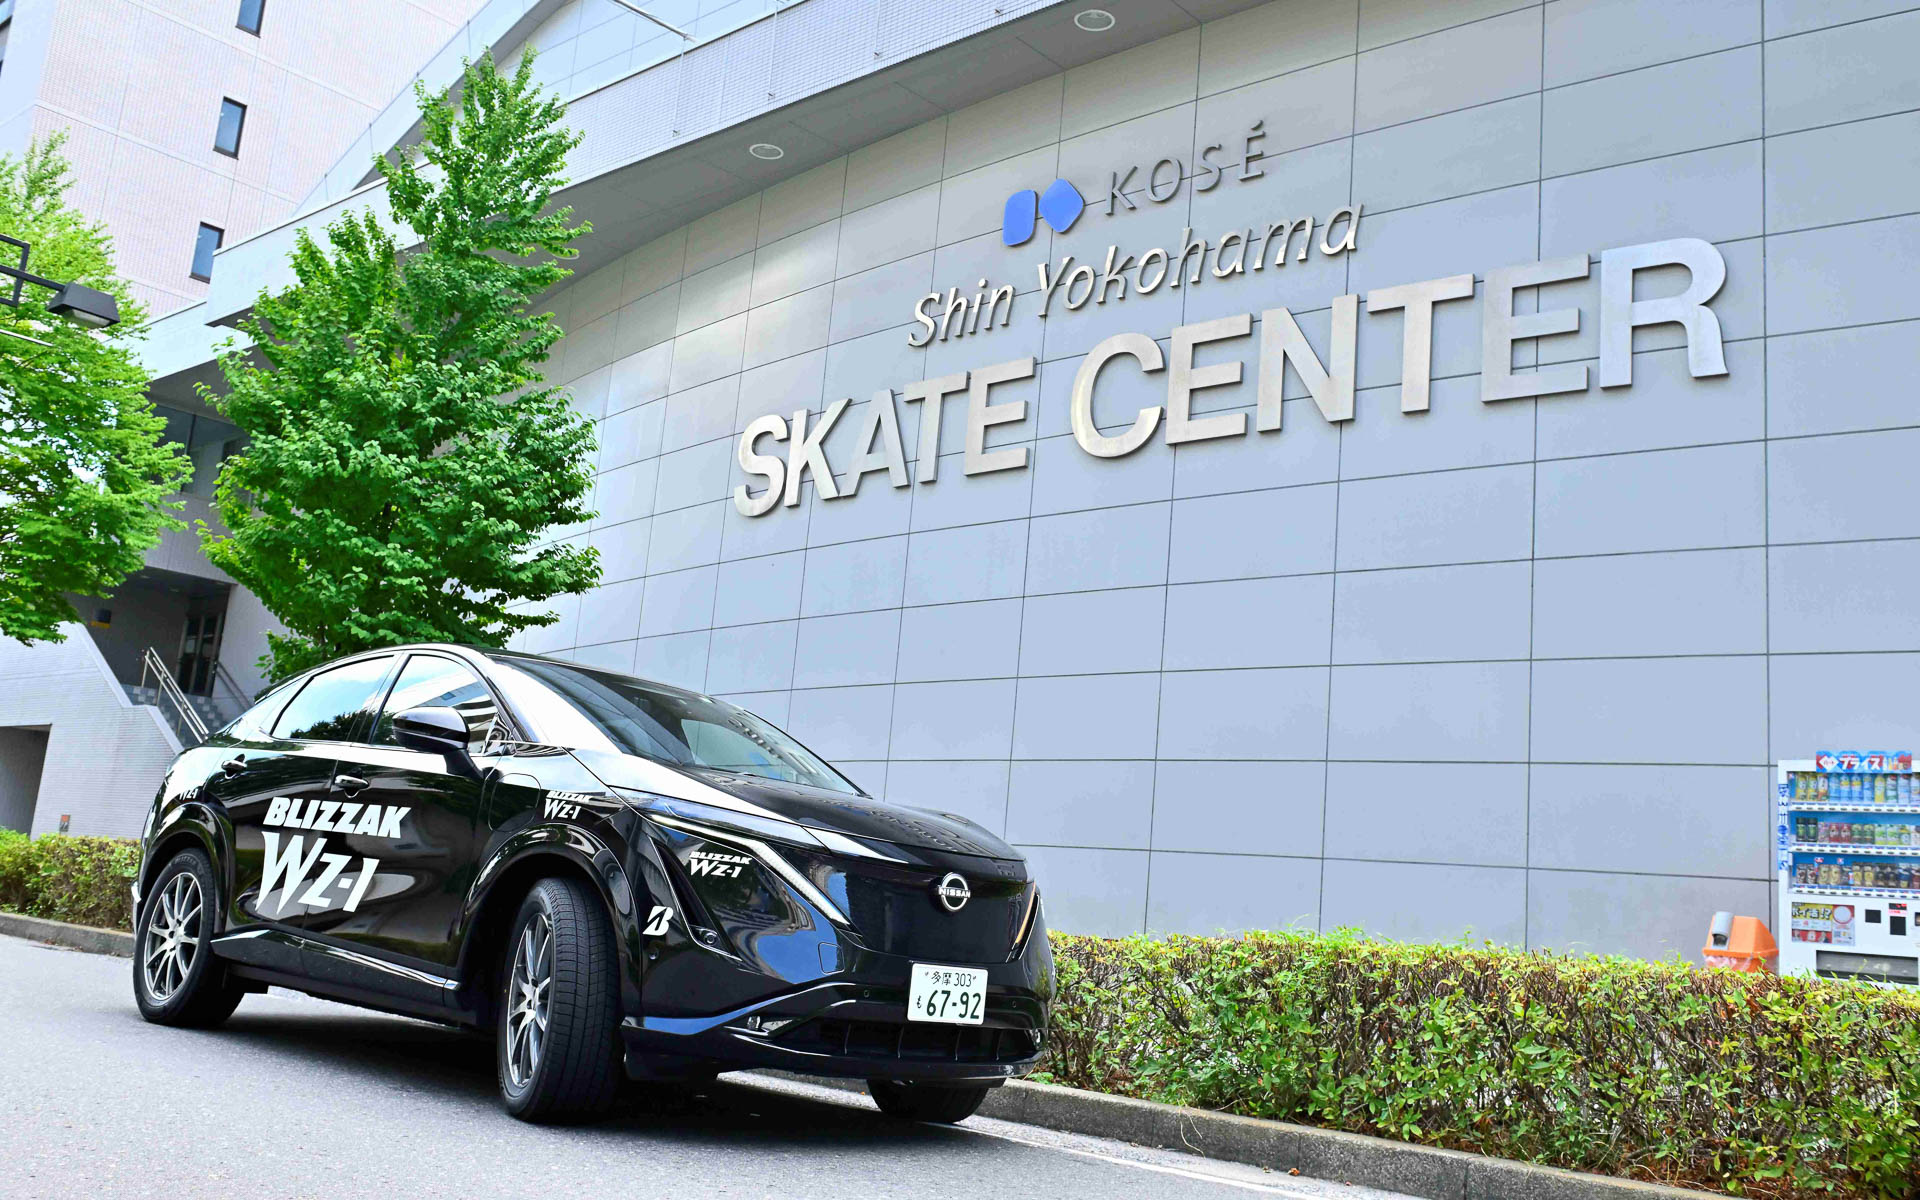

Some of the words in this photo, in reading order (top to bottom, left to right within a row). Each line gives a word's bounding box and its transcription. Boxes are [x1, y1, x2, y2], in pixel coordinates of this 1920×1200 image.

[1105, 121, 1267, 215] KOSÉ
[908, 278, 1016, 347] Shin
[1036, 203, 1363, 318] Yokohama
[734, 356, 1036, 517] SKATE
[1071, 237, 1729, 459] CENTER
[1839, 756, 1881, 771] プライス
[546, 790, 593, 803] BLIZZAK
[263, 796, 412, 839] BLIZZAK
[543, 798, 582, 820] WZ-1
[689, 851, 753, 864] BLIZZAK
[689, 858, 743, 878] WZ-1
[255, 831, 380, 915] WZ-1
[938, 886, 971, 898] NISSAN
[931, 971, 953, 986] 多摩
[954, 972, 972, 987] 303
[926, 990, 981, 1019] 67-92
